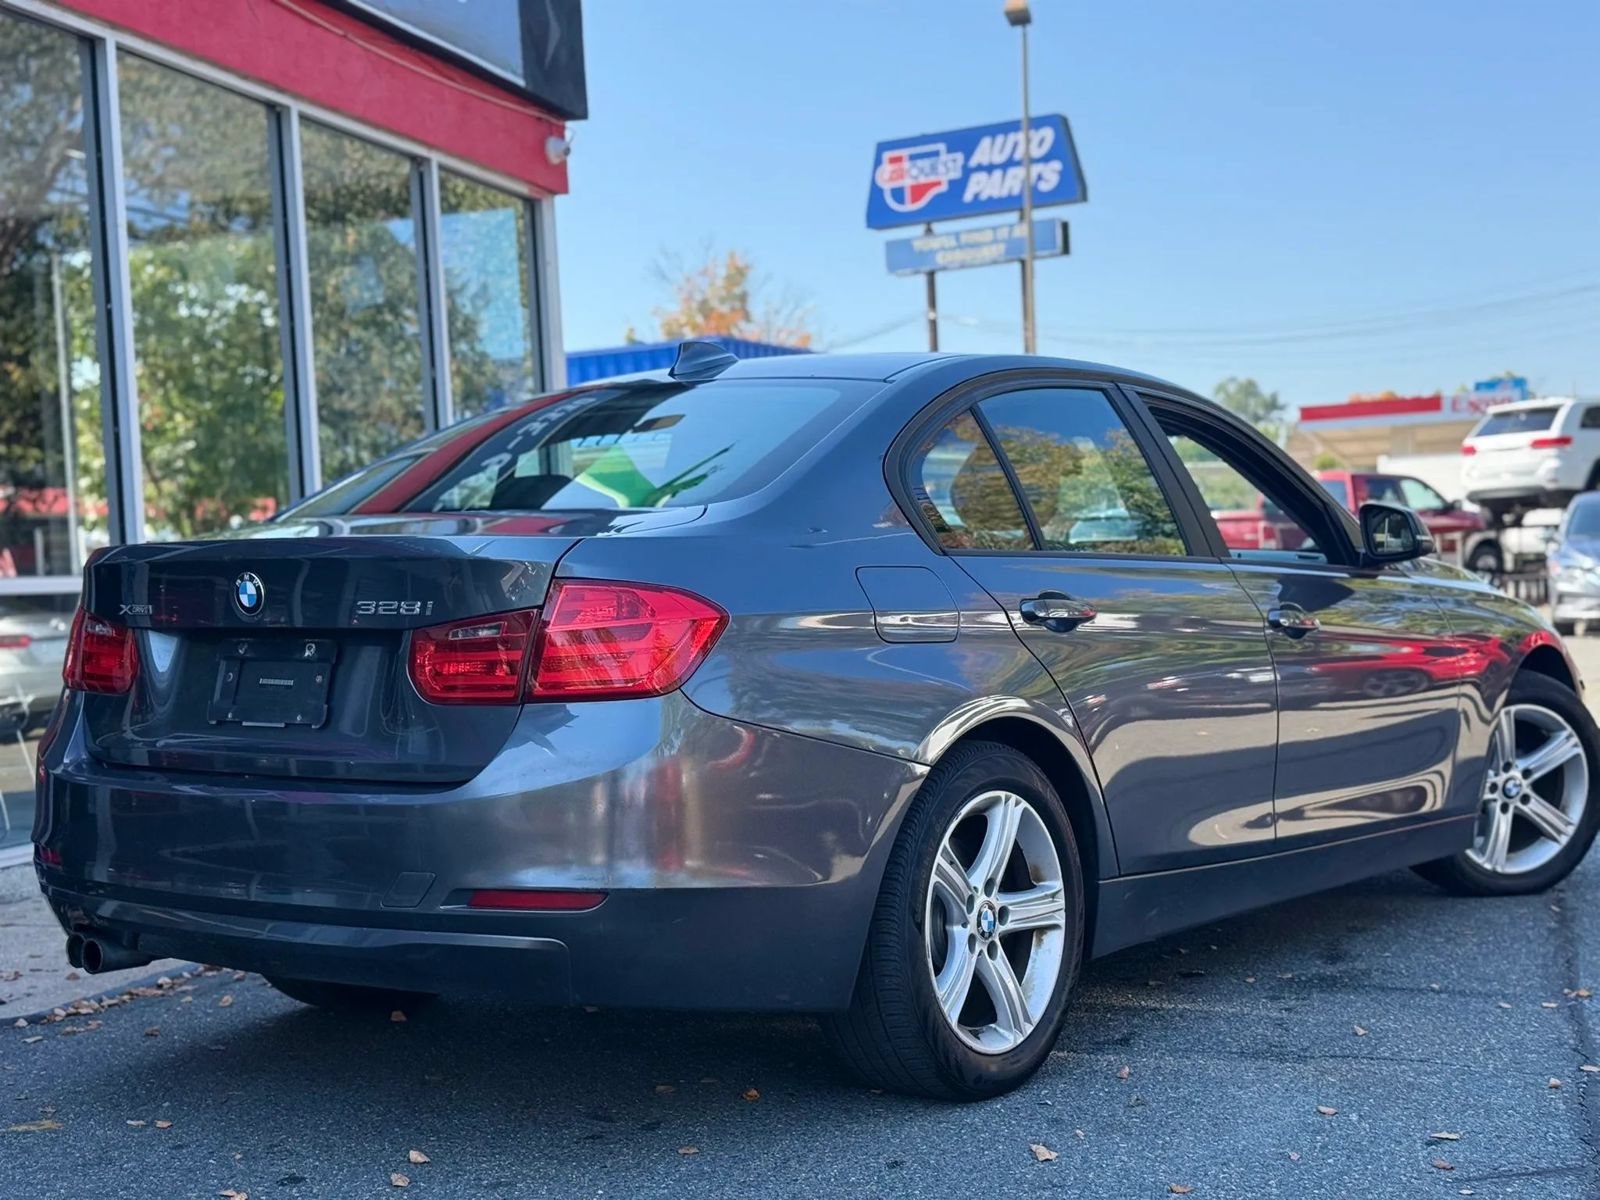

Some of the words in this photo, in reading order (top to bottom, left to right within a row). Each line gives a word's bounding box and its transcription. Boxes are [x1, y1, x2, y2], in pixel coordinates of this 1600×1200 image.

[968, 126, 1055, 168] AUTO
[963, 161, 1063, 203] PARTS
[356, 600, 433, 616] 328i
